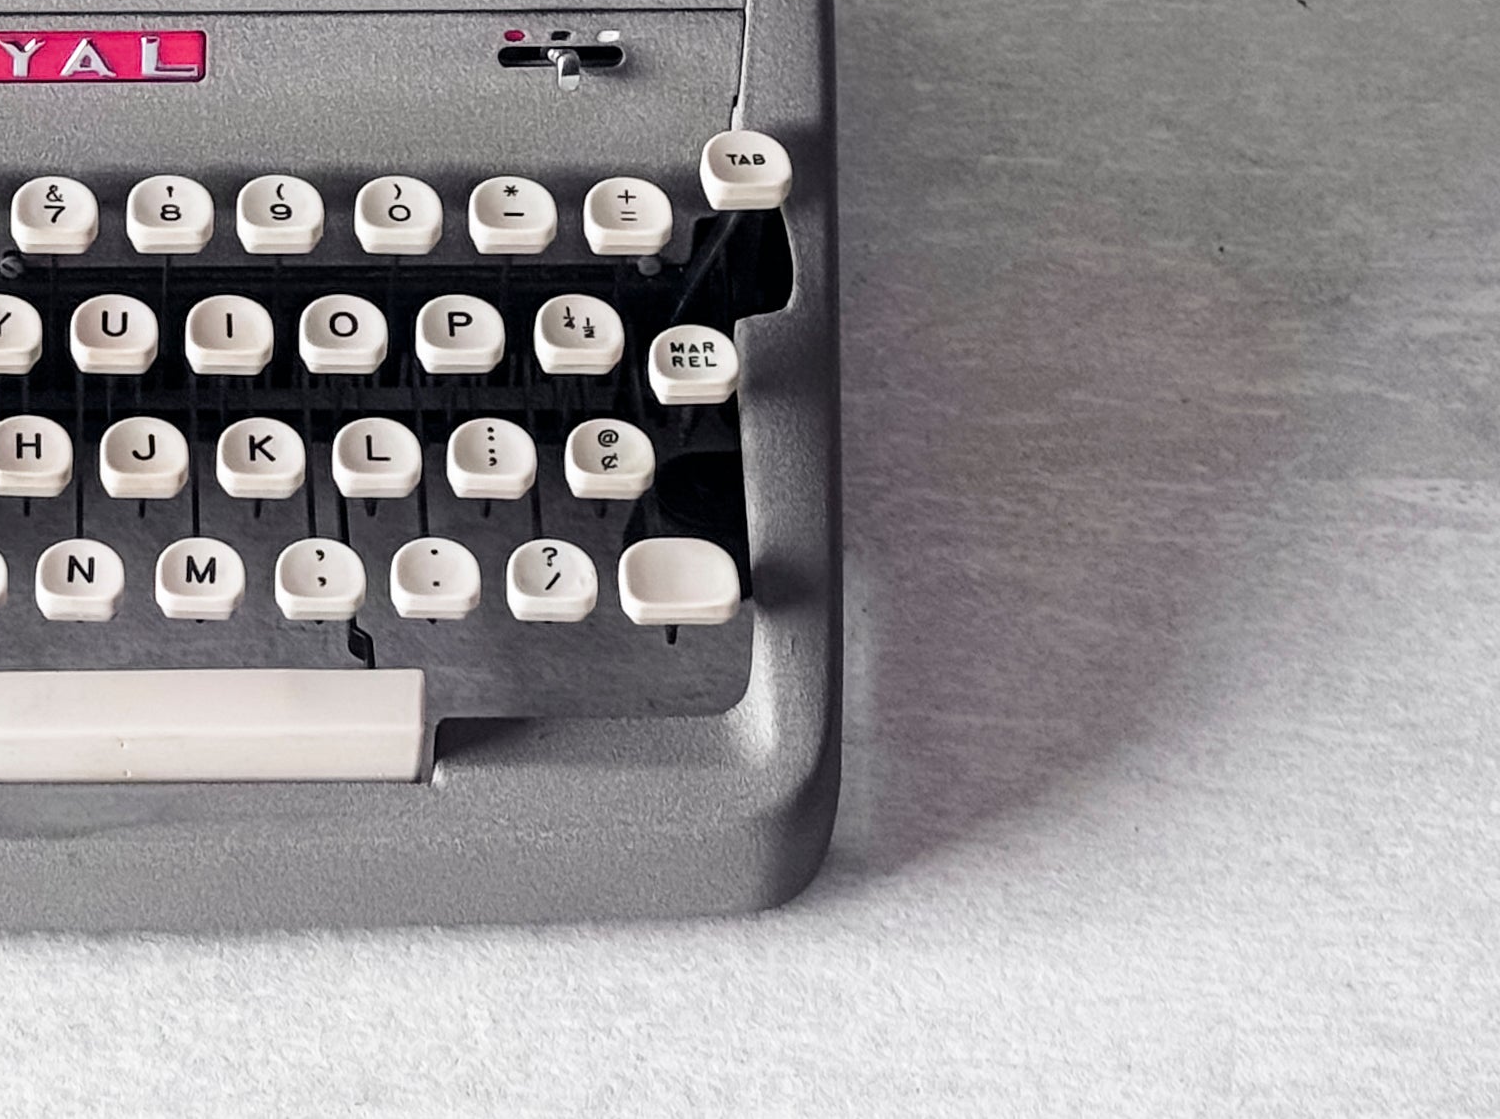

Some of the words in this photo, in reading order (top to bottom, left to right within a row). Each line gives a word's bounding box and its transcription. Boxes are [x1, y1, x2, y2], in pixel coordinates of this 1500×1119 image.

[725, 153, 766, 166] TAB
[45, 184, 64, 203] &
[275, 183, 285, 201] (
[393, 183, 402, 200] )
[617, 189, 637, 205] +
[43, 204, 66, 224] 7
[159, 203, 182, 222] 8
[269, 203, 293, 221] 9
[620, 211, 637, 222] =
[101, 310, 128, 338] U
[225, 312, 234, 339] I
[328, 311, 359, 338] O
[447, 311, 473, 338] P
[669, 341, 715, 354] MAR
[671, 355, 717, 368] REL
[15, 432, 42, 460] H
[131, 433, 156, 462] J
[248, 434, 276, 462] K
[365, 434, 391, 462] L
[597, 429, 620, 448] @
[541, 546, 558, 568] ?
[66, 554, 95, 584] N
[185, 555, 217, 584] M
